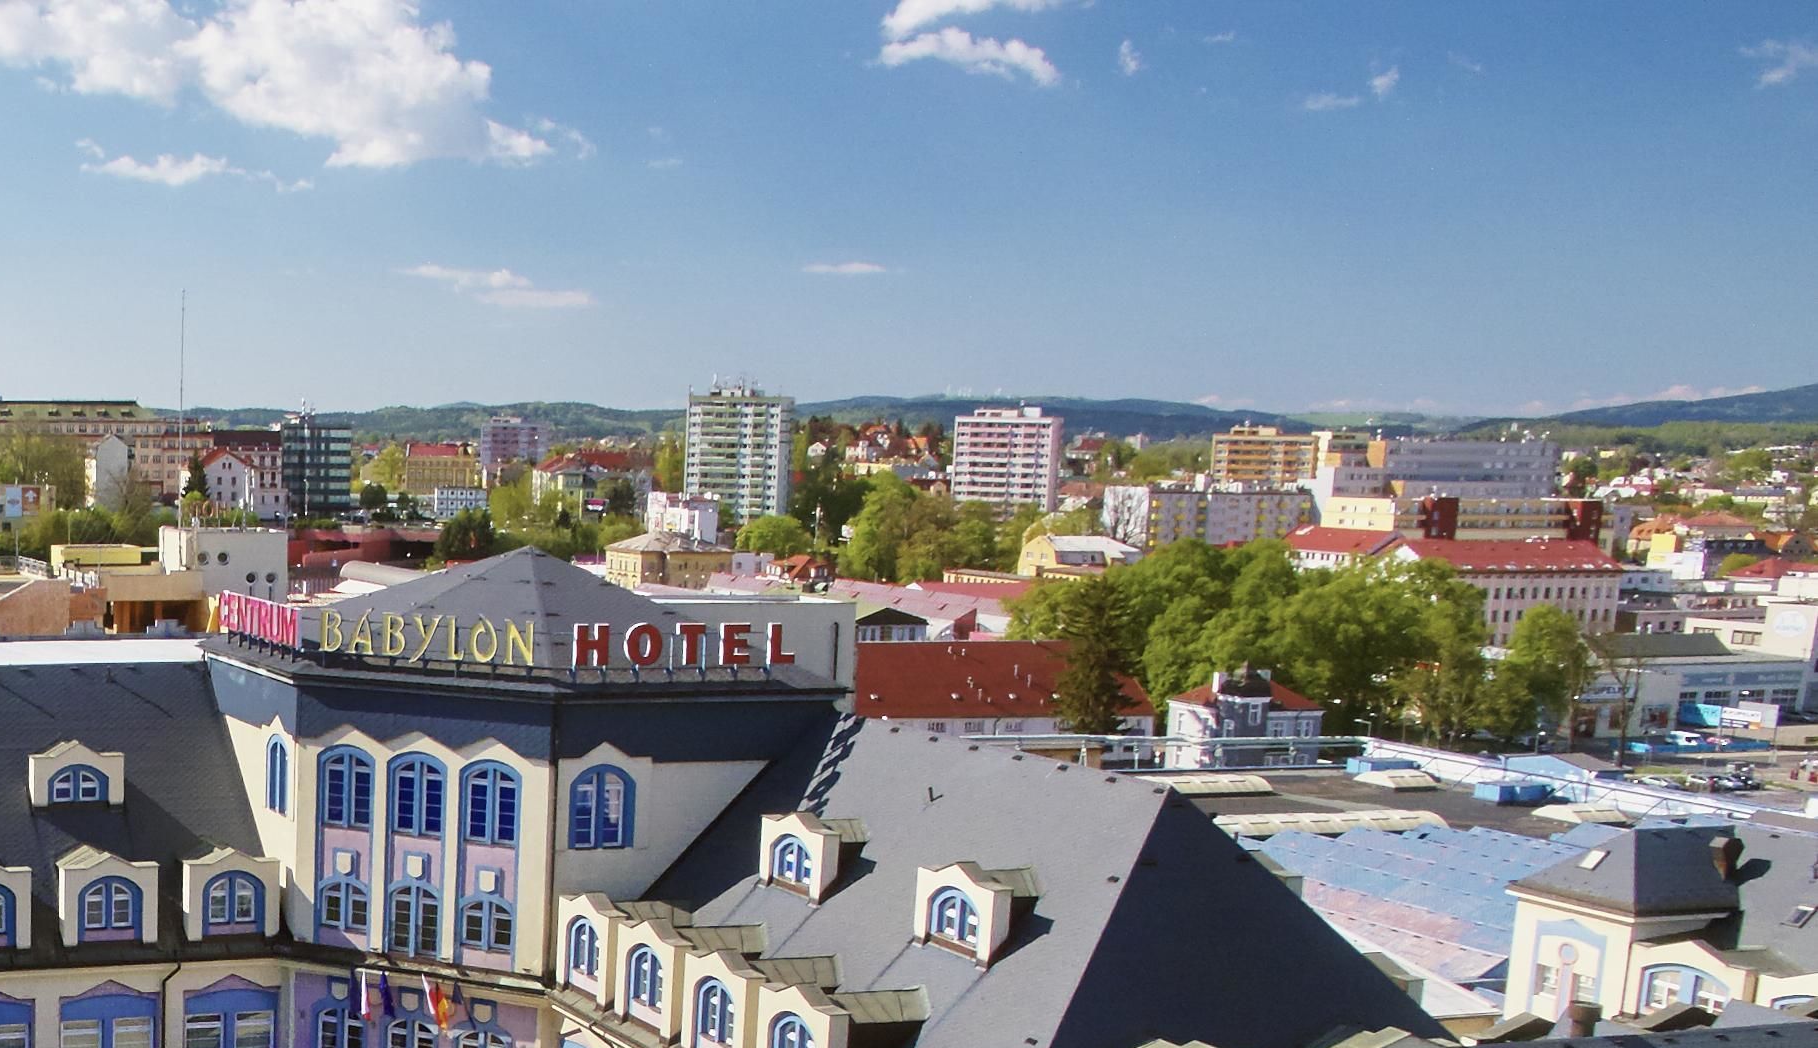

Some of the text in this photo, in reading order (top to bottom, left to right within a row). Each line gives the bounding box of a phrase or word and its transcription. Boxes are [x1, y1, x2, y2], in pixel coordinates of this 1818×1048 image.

[219, 589, 299, 650] CENTRUM
[319, 607, 796, 667] BABYLON HOTEL
